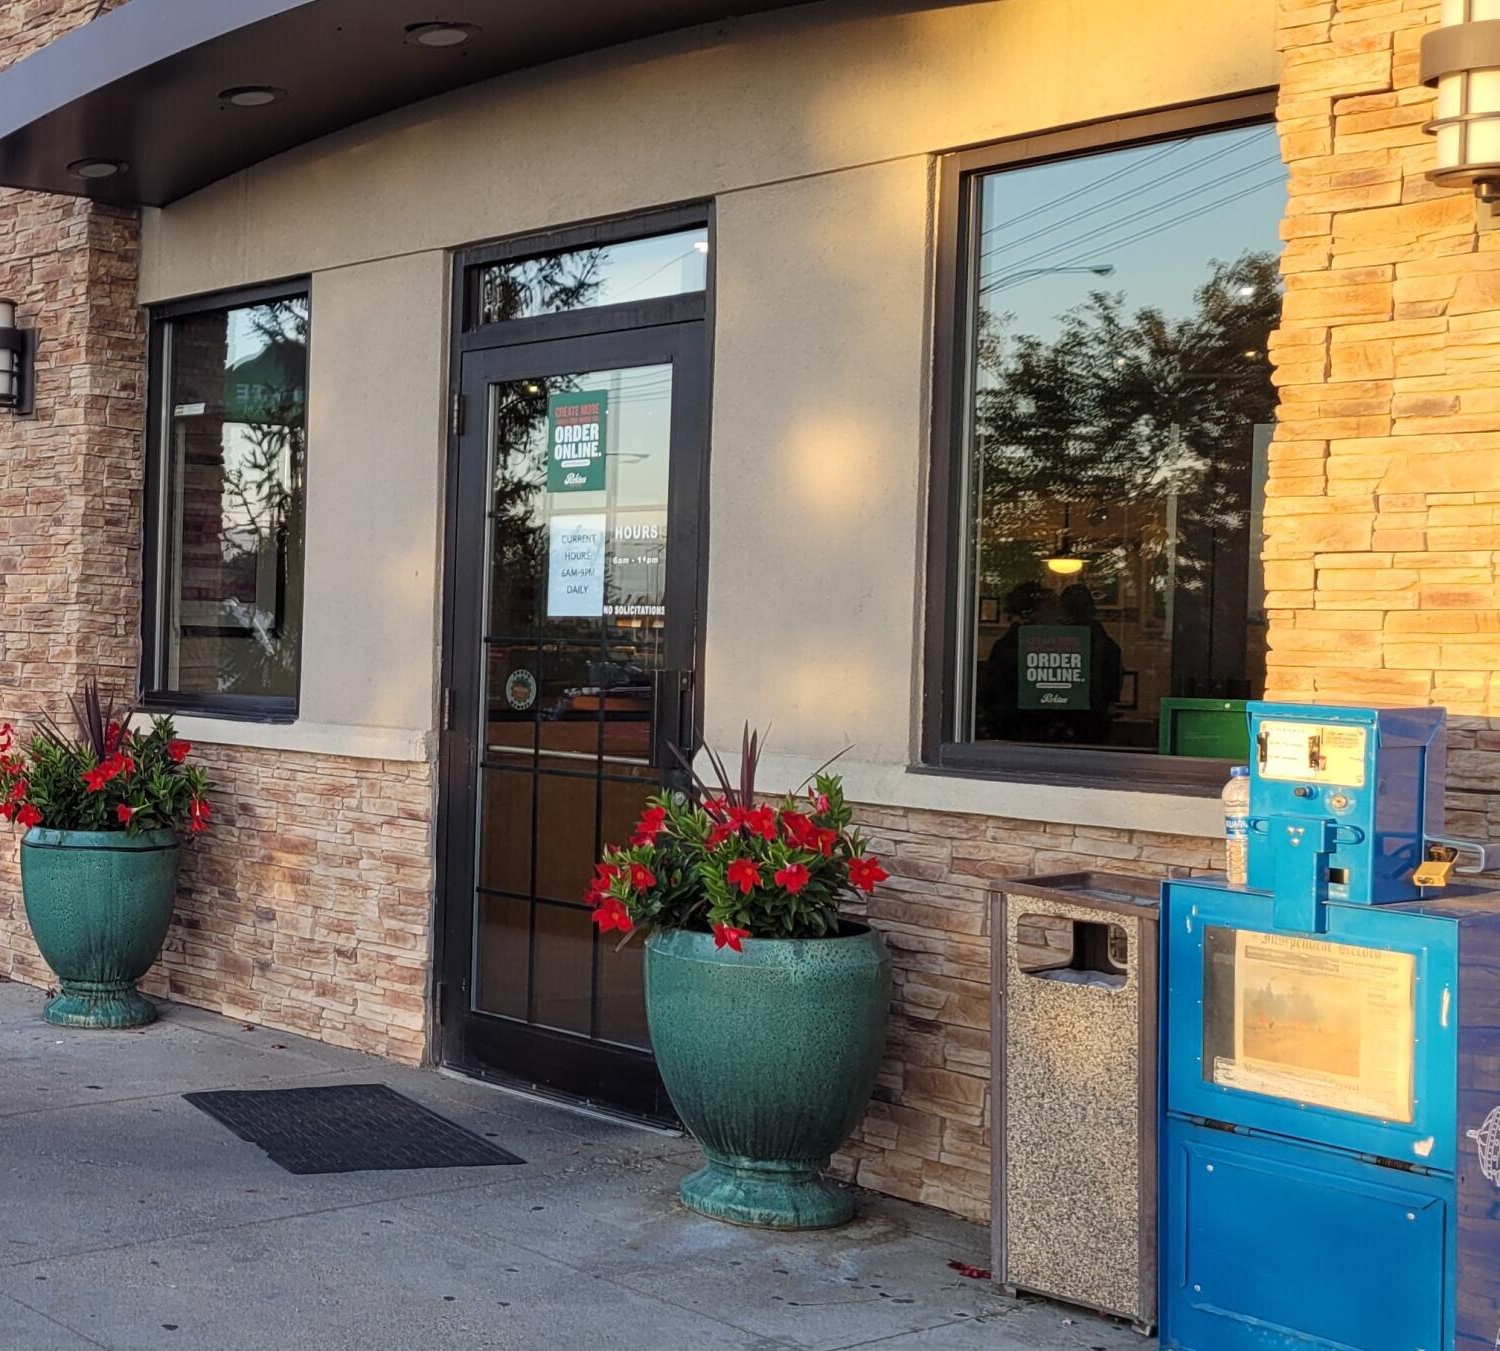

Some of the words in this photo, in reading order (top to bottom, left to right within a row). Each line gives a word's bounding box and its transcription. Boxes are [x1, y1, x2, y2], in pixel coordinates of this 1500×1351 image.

[554, 423, 599, 443] ORDER
[554, 441, 602, 460] ONLINE.
[615, 525, 658, 540] HOURS
[561, 534, 597, 544] CURRENT
[612, 556, 629, 564] 6am
[561, 568, 595, 577] 6AM-9PM
[566, 585, 589, 594] DAILY
[604, 605, 612, 614] NO
[614, 604, 666, 615] SOLICITATIONS
[1027, 653, 1081, 668] ORDER
[1027, 668, 1085, 682] ONLINE.
